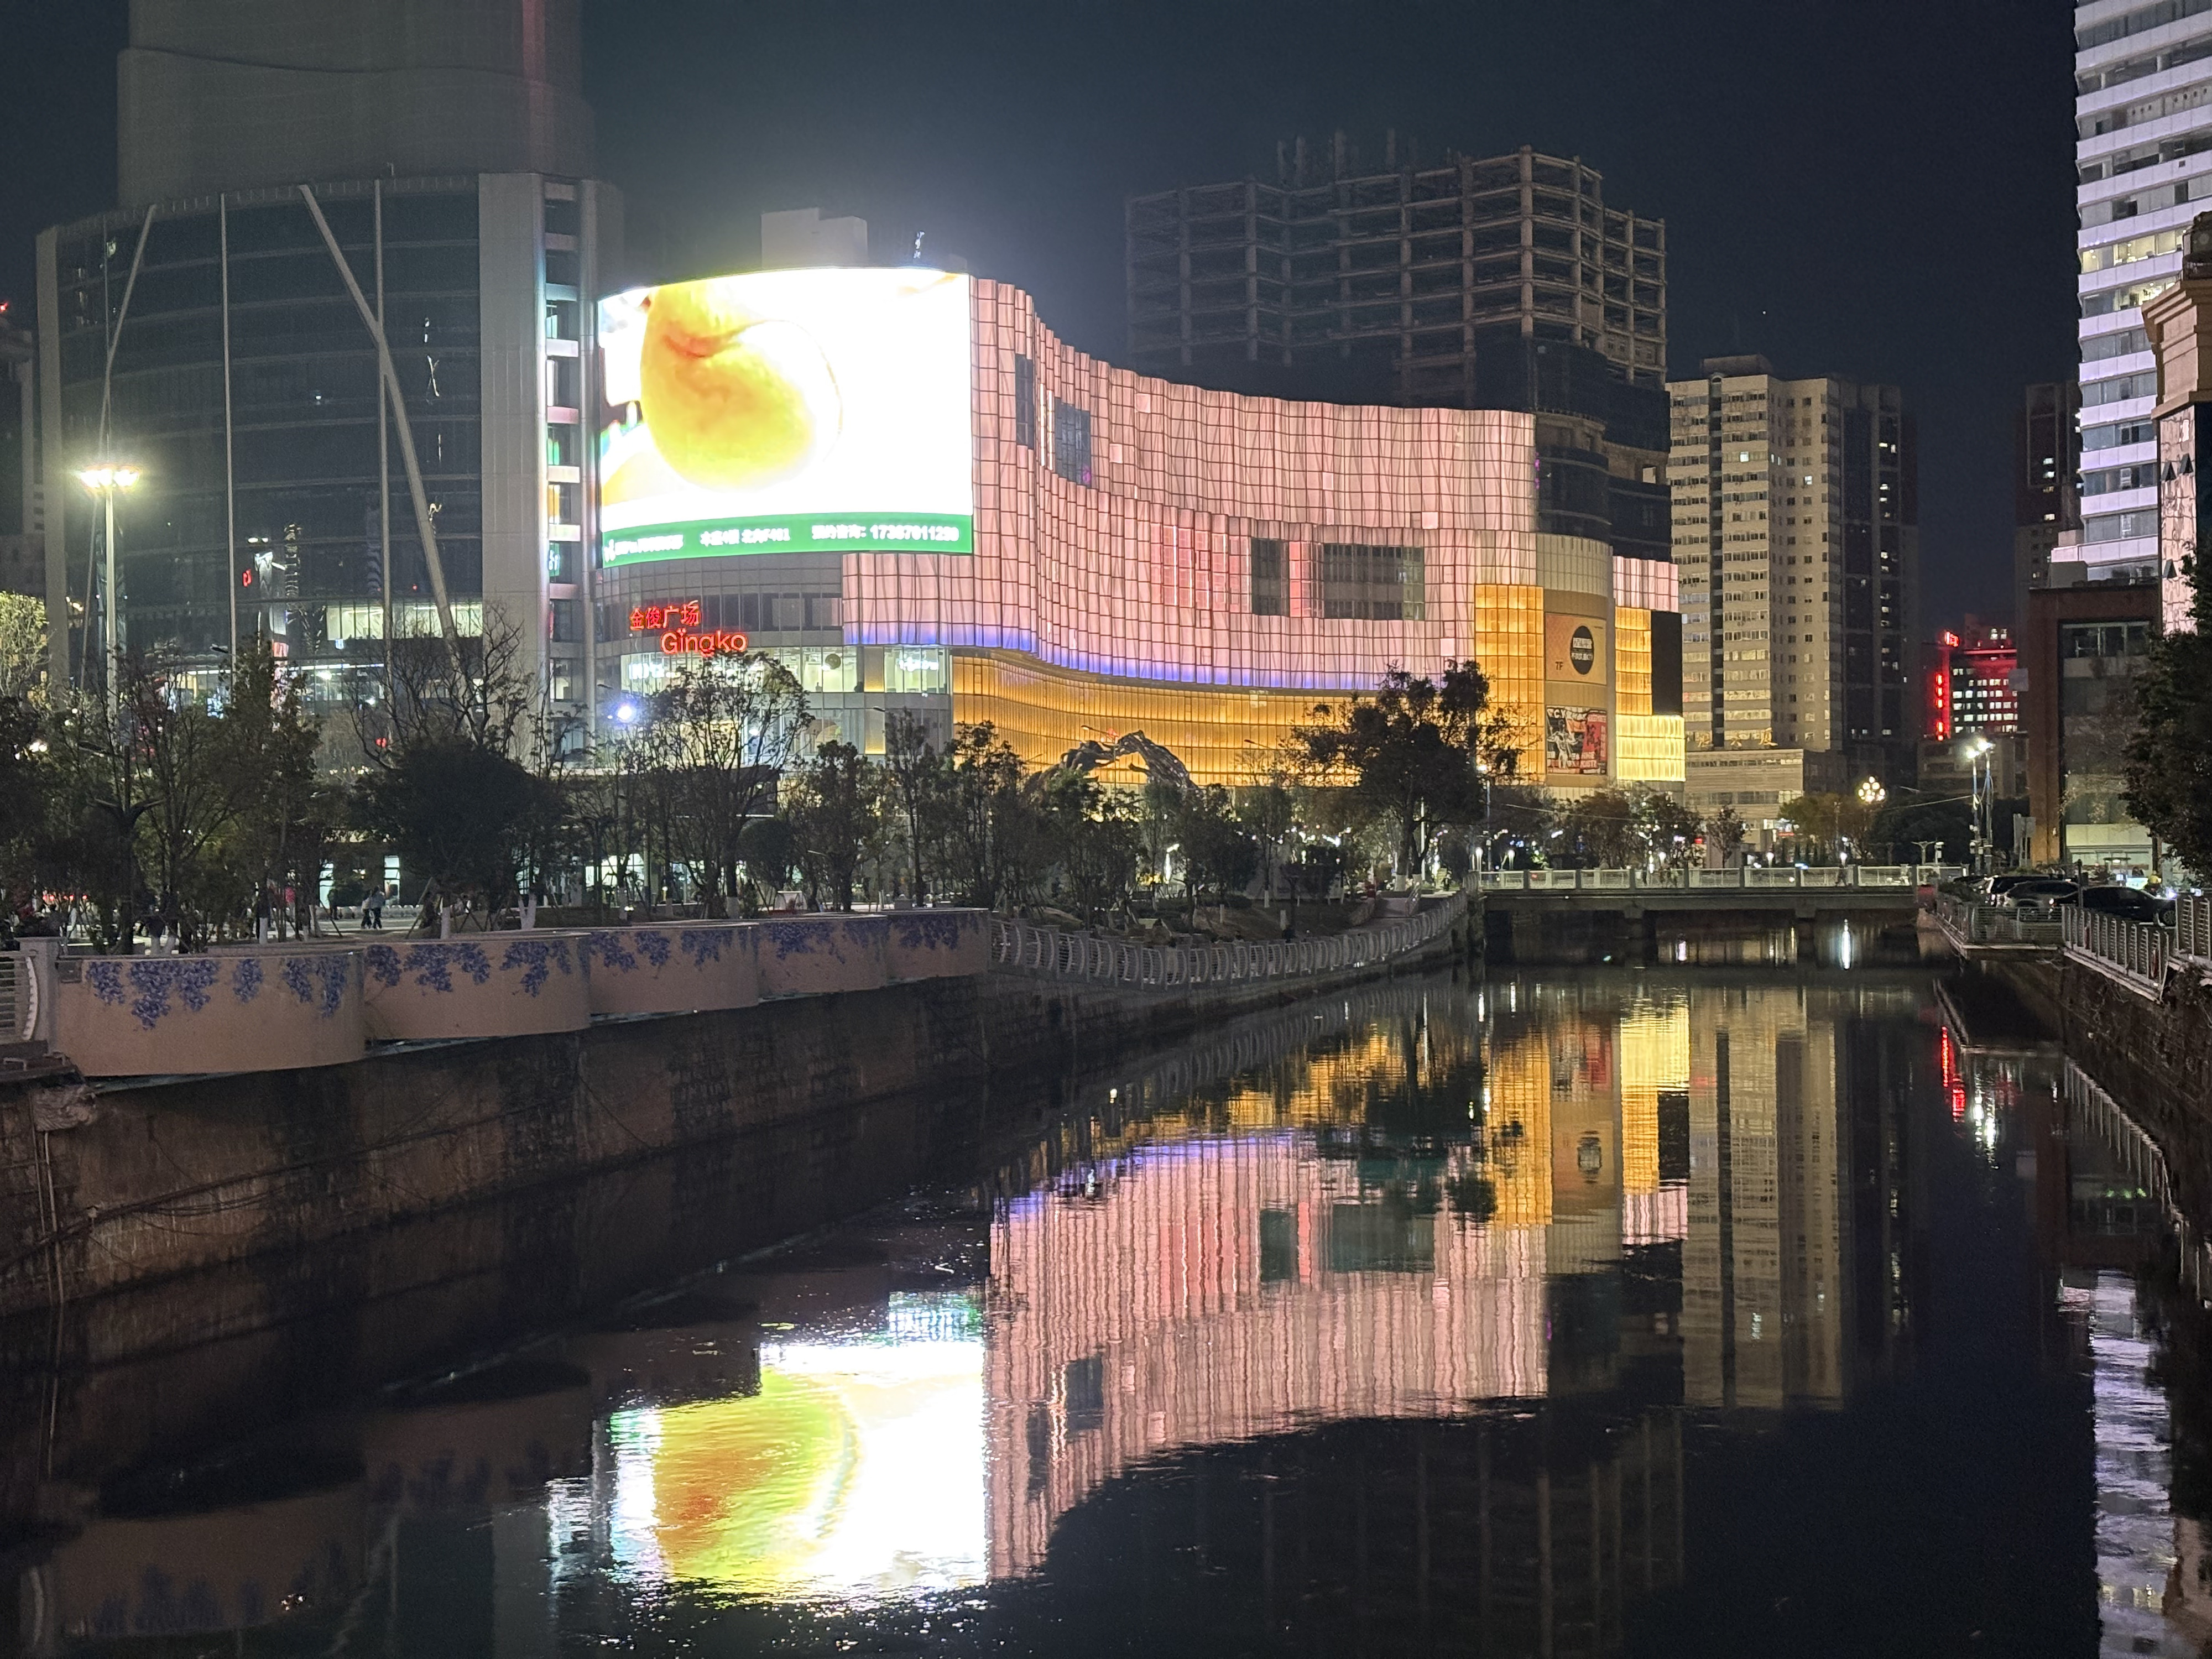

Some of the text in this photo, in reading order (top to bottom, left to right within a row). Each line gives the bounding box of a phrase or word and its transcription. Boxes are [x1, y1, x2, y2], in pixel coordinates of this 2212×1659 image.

[629, 600, 701, 630] 金俊广场
[660, 627, 748, 658] Gingko
